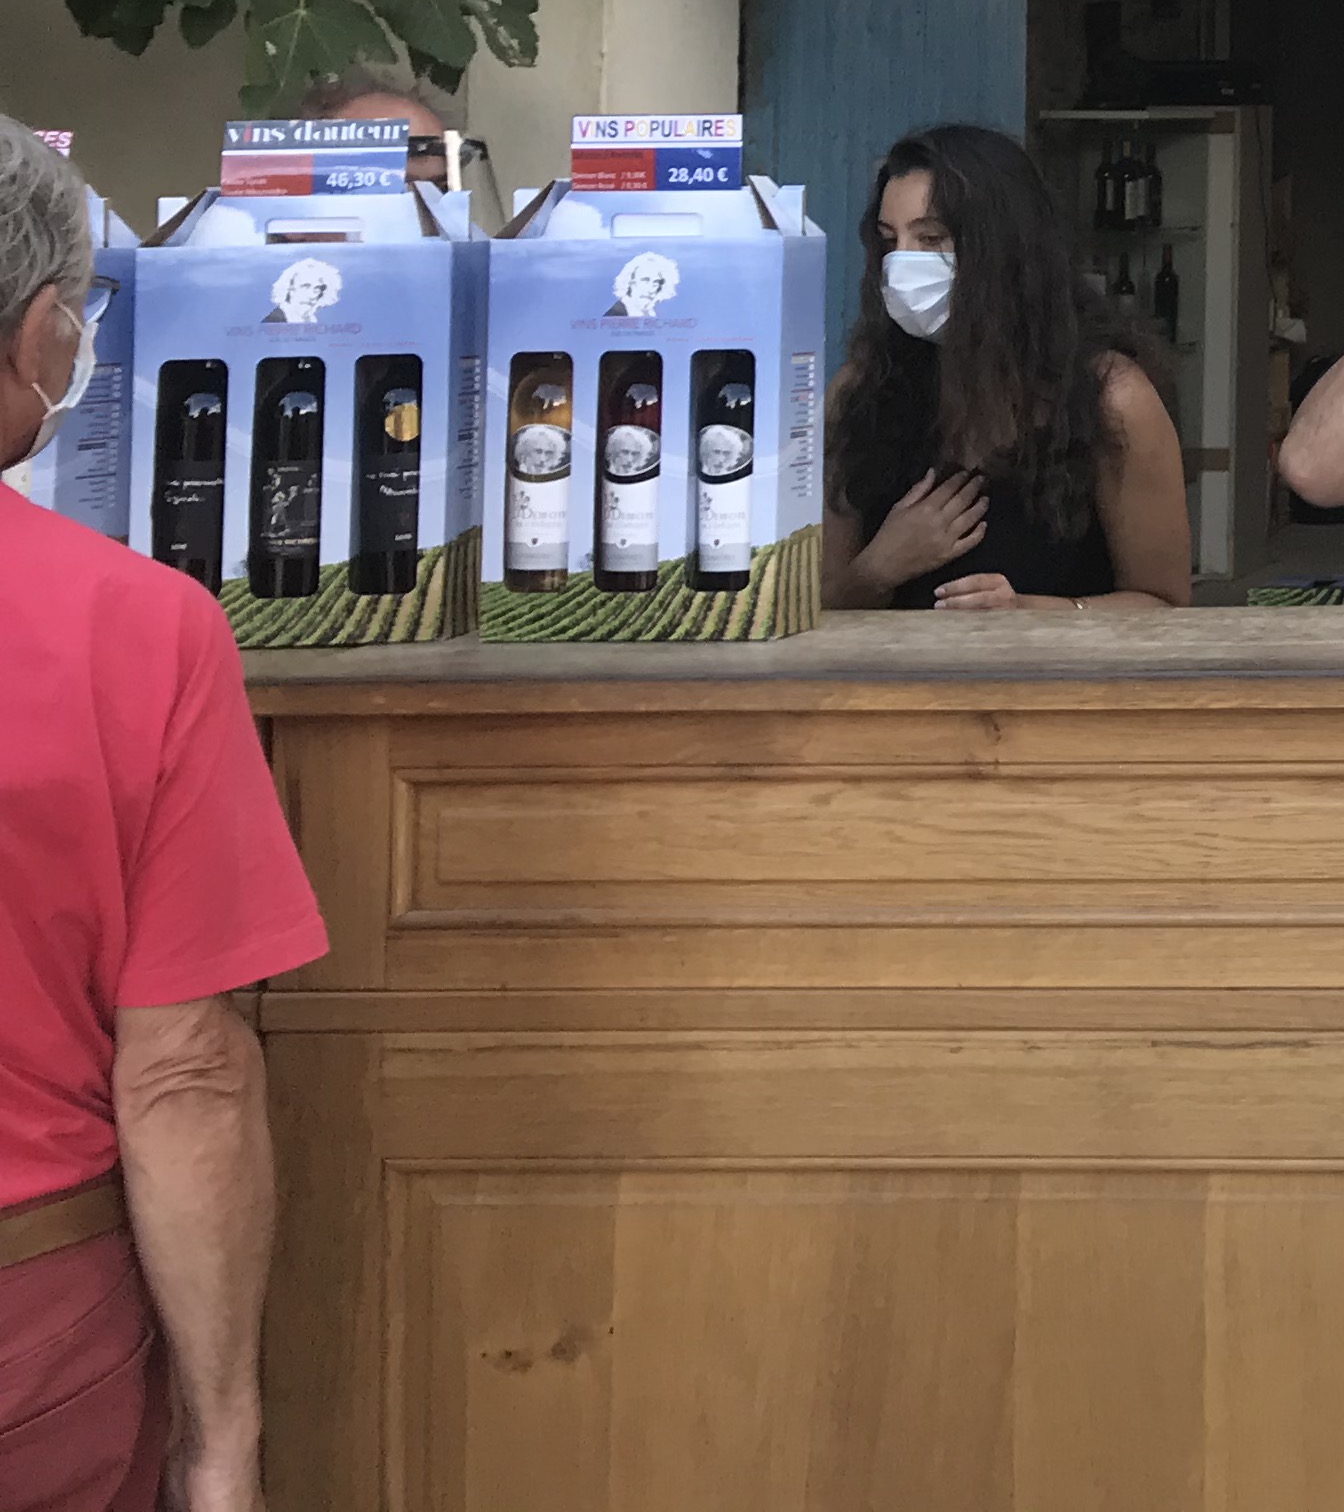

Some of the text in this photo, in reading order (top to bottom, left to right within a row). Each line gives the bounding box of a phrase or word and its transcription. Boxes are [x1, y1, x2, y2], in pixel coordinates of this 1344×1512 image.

[228, 124, 286, 143] vins
[578, 119, 736, 138] VINS POPULAIRES
[326, 171, 391, 189] 46,30 €
[668, 167, 728, 185] 28,40 €
